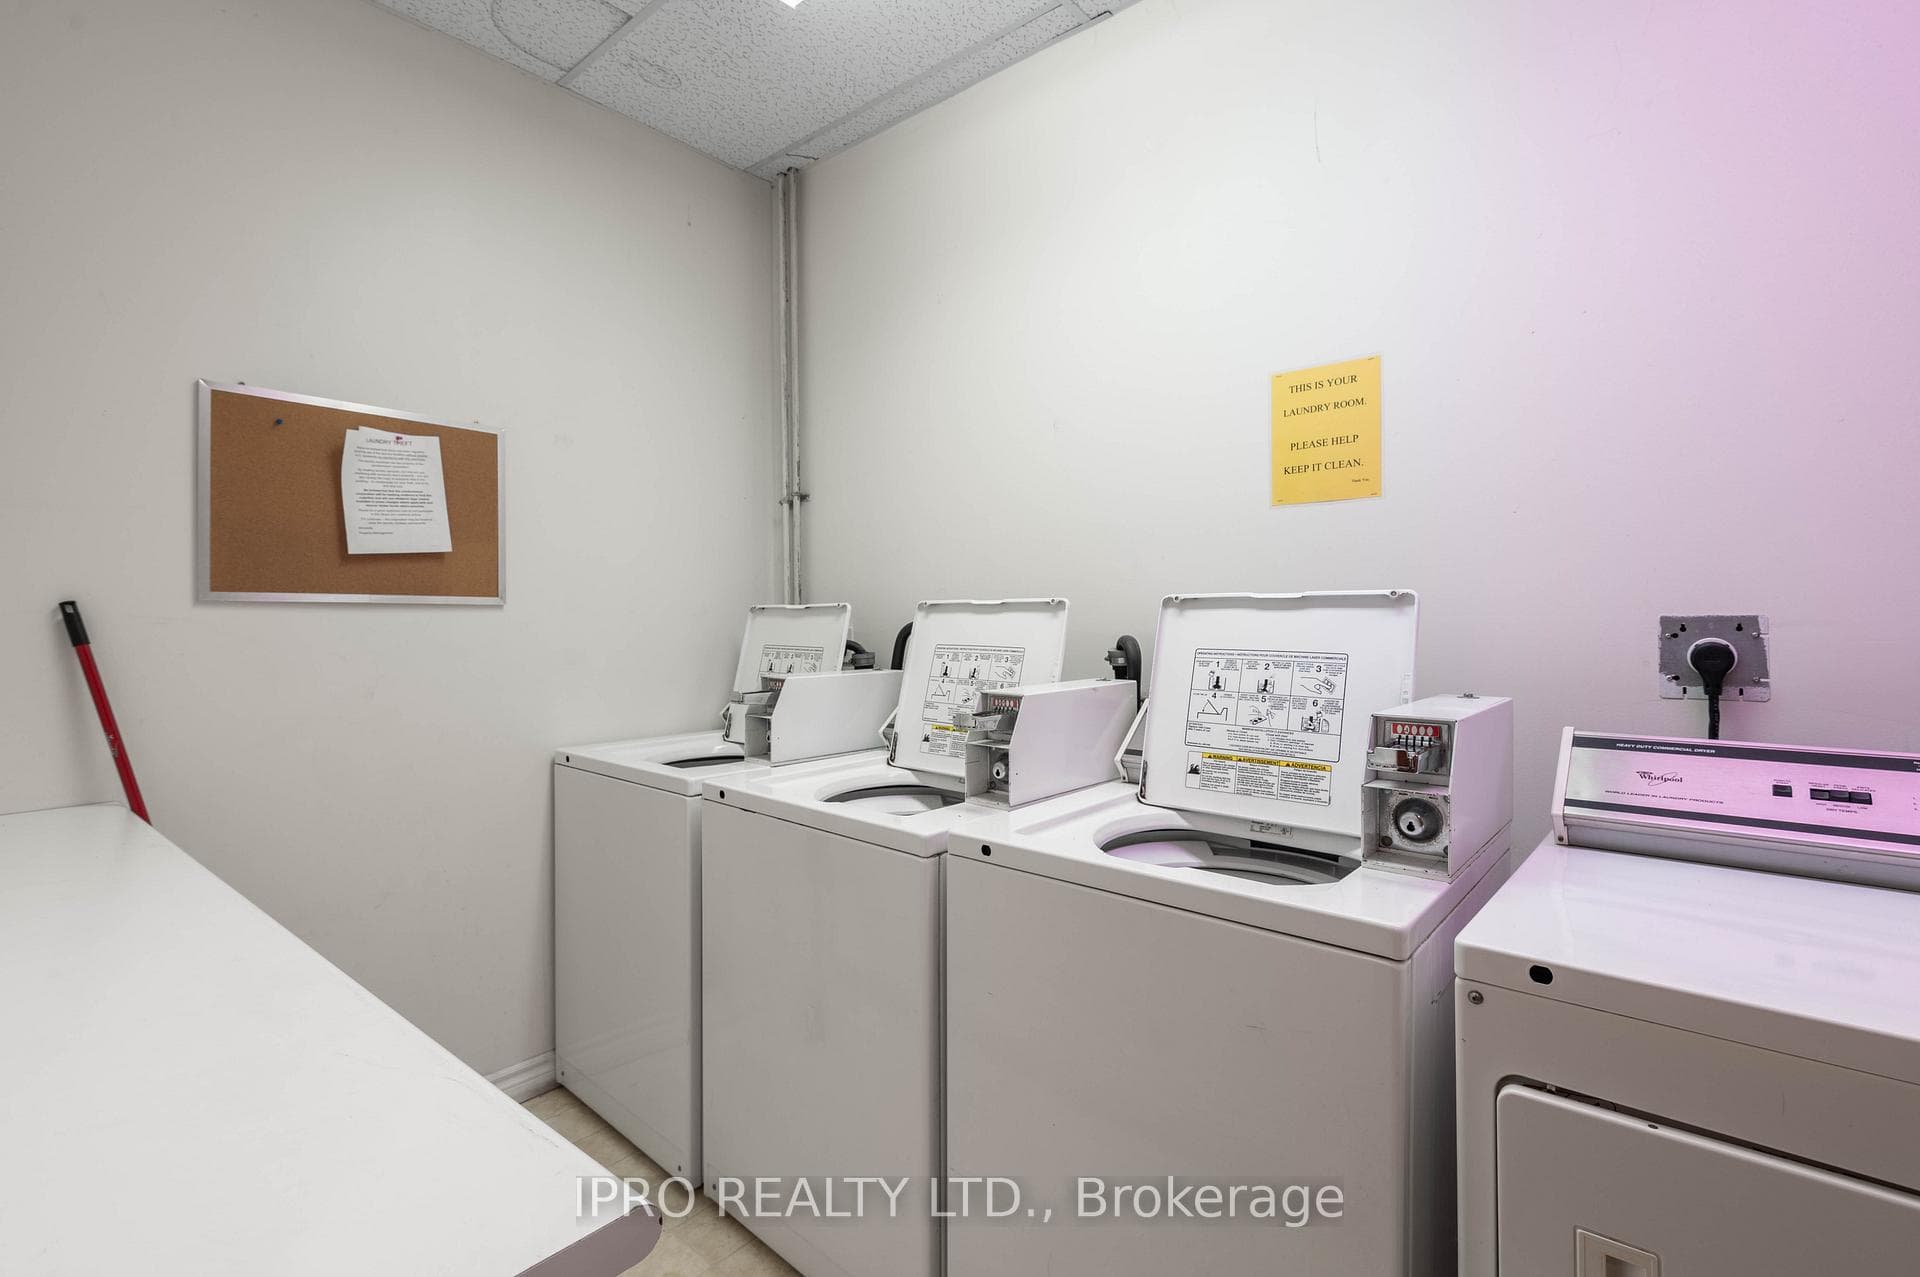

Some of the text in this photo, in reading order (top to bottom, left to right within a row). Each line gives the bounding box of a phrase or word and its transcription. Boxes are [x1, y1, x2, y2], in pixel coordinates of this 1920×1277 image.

[1288, 374, 1358, 394] THIS IS YOUR
[1283, 397, 1367, 418] LAUNDRY ROOM.
[1290, 434, 1359, 451] PLEASE HELP
[1284, 458, 1364, 476] KEEP IT CLEAN.
[1639, 773, 1683, 785] Whirlpool
